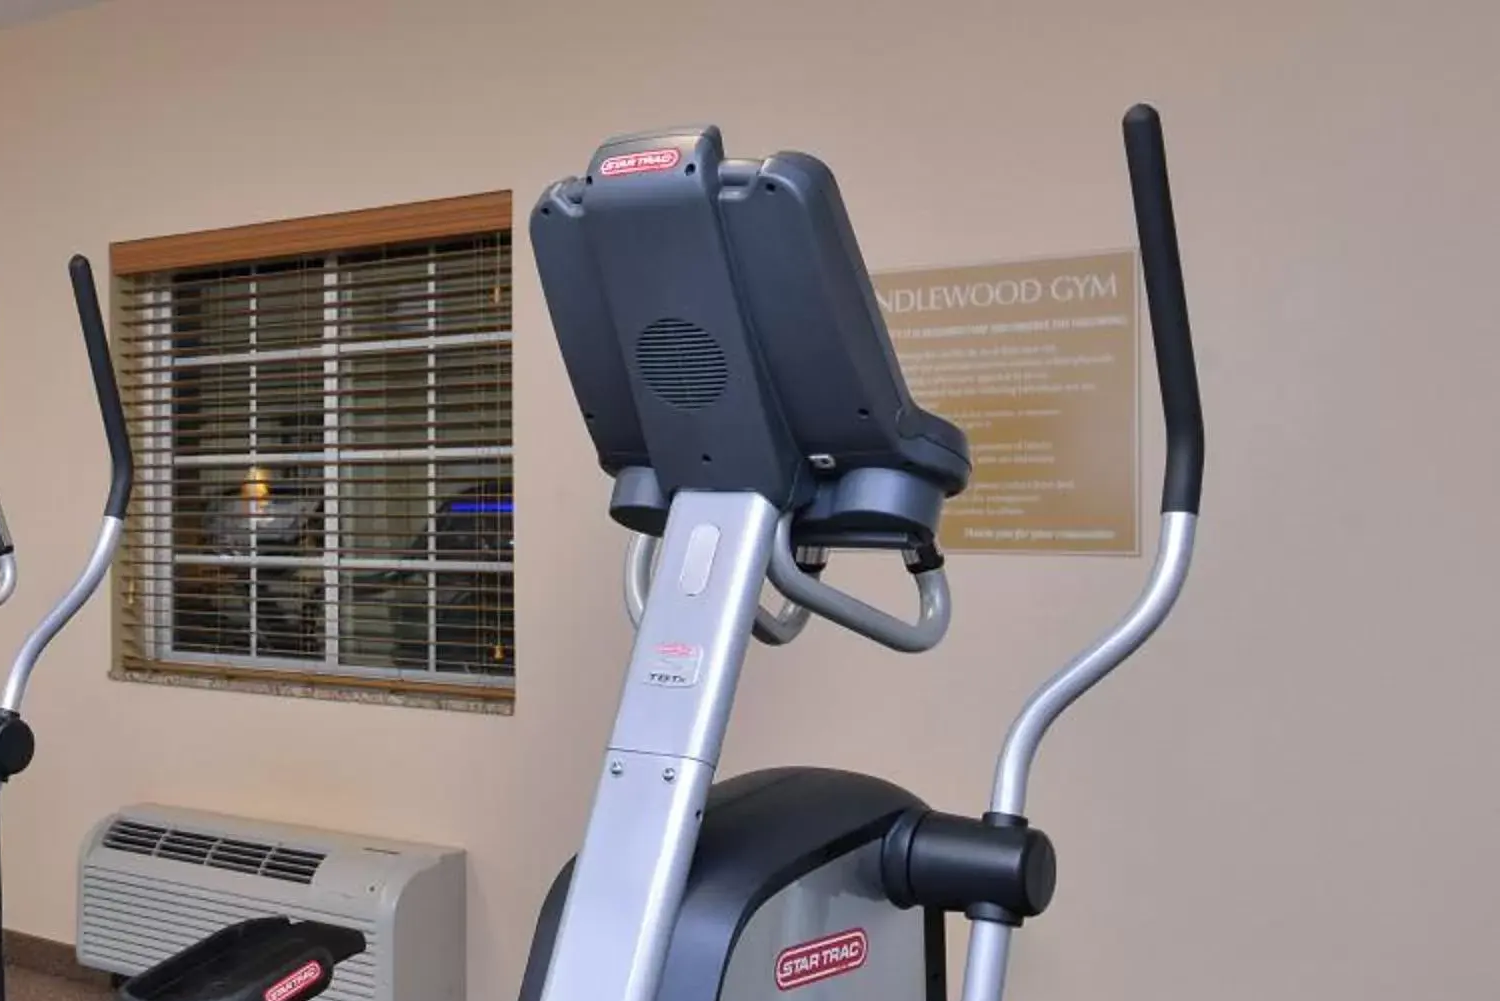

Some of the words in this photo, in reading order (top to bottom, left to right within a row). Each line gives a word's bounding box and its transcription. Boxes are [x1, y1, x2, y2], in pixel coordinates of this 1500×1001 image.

[875, 278, 1042, 313] NDLEWOOD
[1050, 271, 1118, 301] GYM
[782, 953, 819, 977] STAR
[821, 940, 860, 965] TRAC
